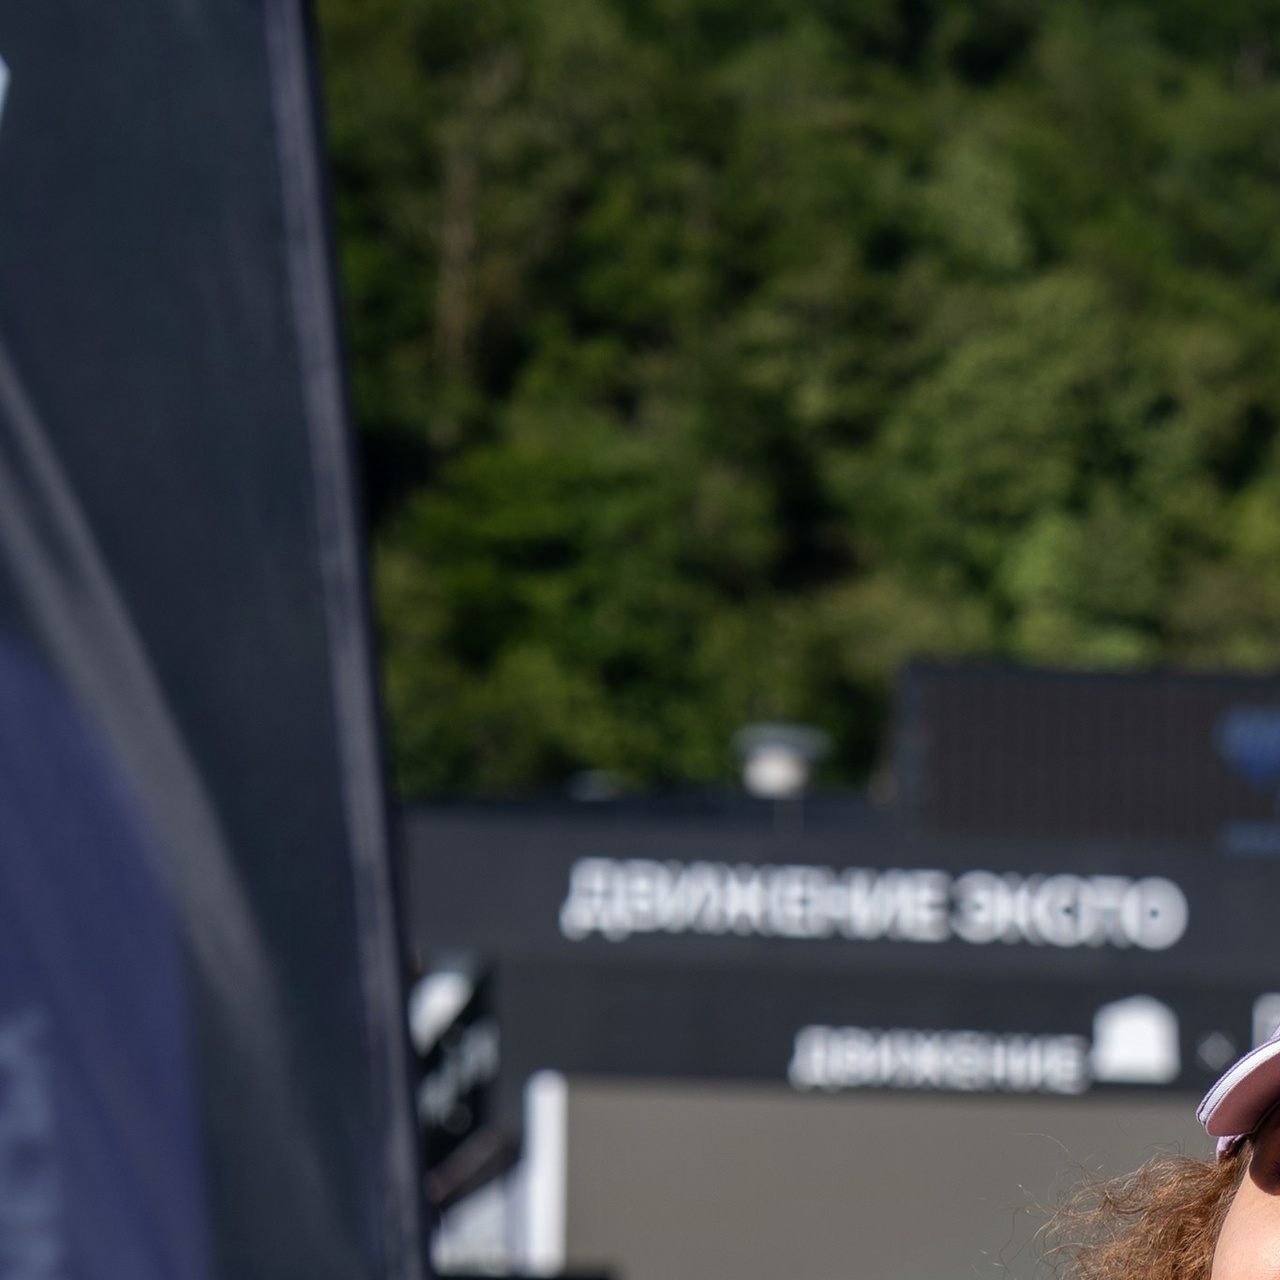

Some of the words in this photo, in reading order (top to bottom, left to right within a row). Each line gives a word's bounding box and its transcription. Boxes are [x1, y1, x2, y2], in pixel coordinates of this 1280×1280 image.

[560, 857, 951, 941] ДВИЖЕНИЕ
[953, 868, 1189, 950] ЭКСПО
[789, 1025, 1091, 1094] ДВИЖЕНИЕ
